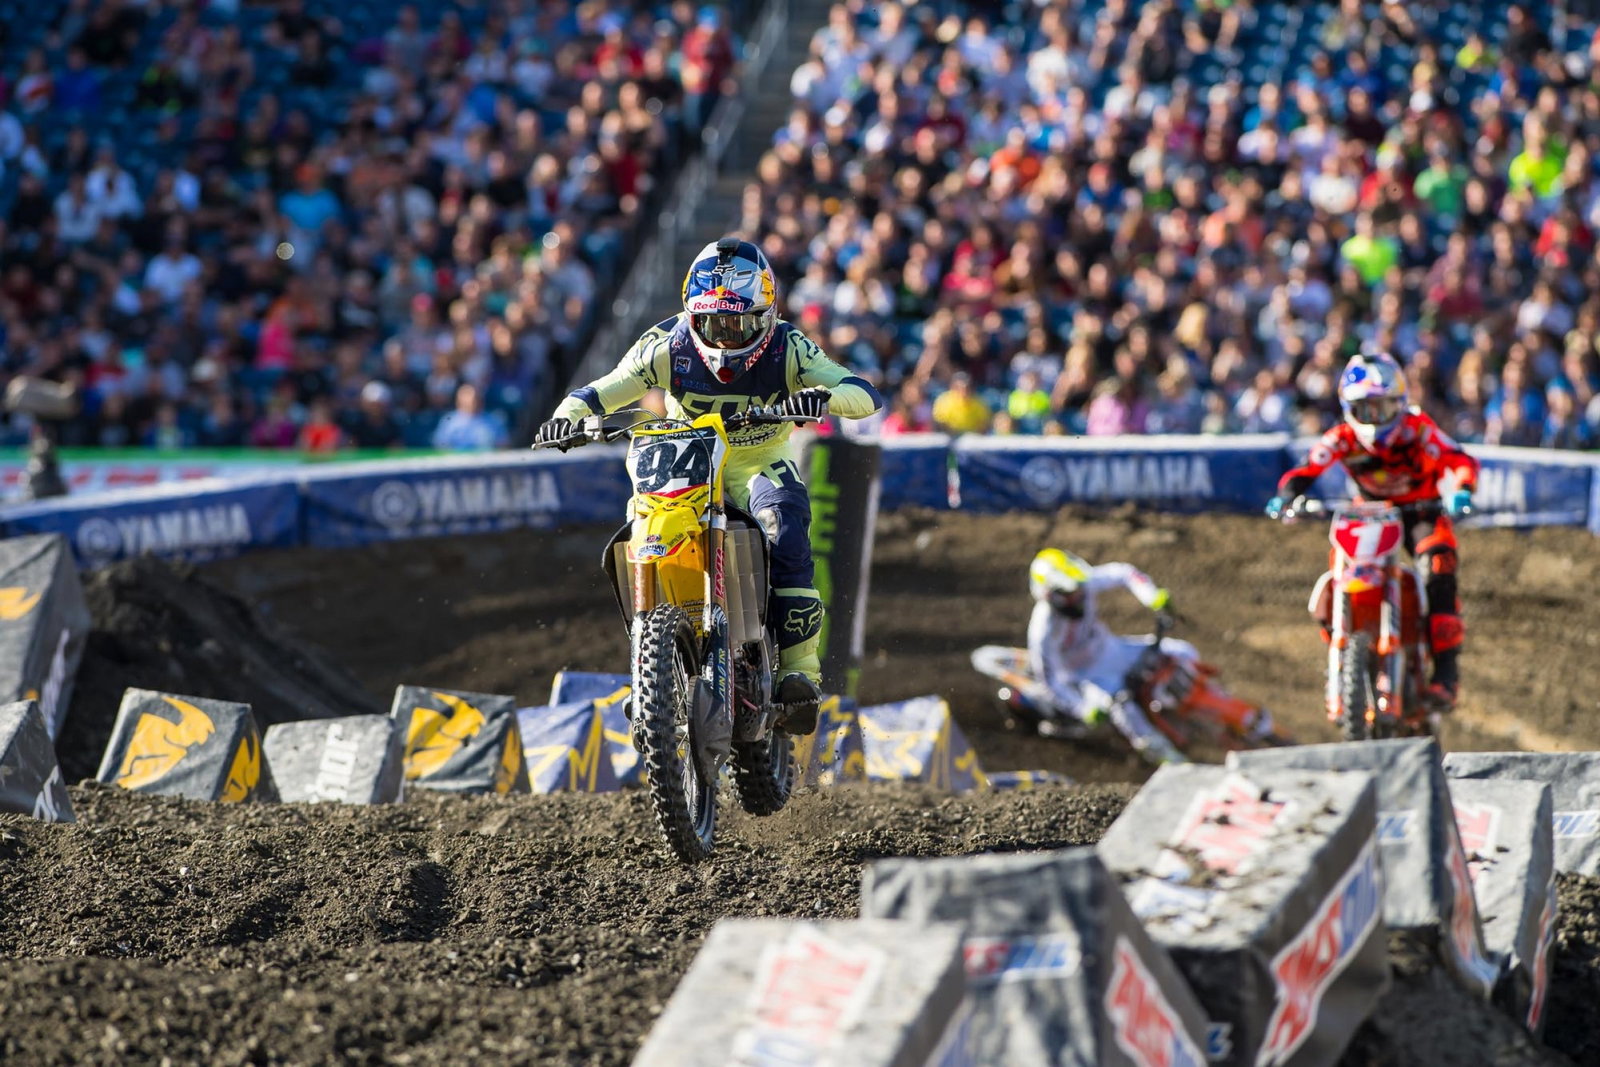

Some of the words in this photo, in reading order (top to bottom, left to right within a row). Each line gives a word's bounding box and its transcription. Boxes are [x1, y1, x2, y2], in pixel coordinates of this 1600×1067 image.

[693, 300, 719, 311] Red
[718, 300, 745, 312] Bull
[636, 438, 717, 494] 94
[1065, 456, 1214, 499] YAMAHA
[415, 471, 561, 521] YAMAHA
[117, 503, 251, 556] YAMAHA
[1349, 522, 1382, 560] 1
